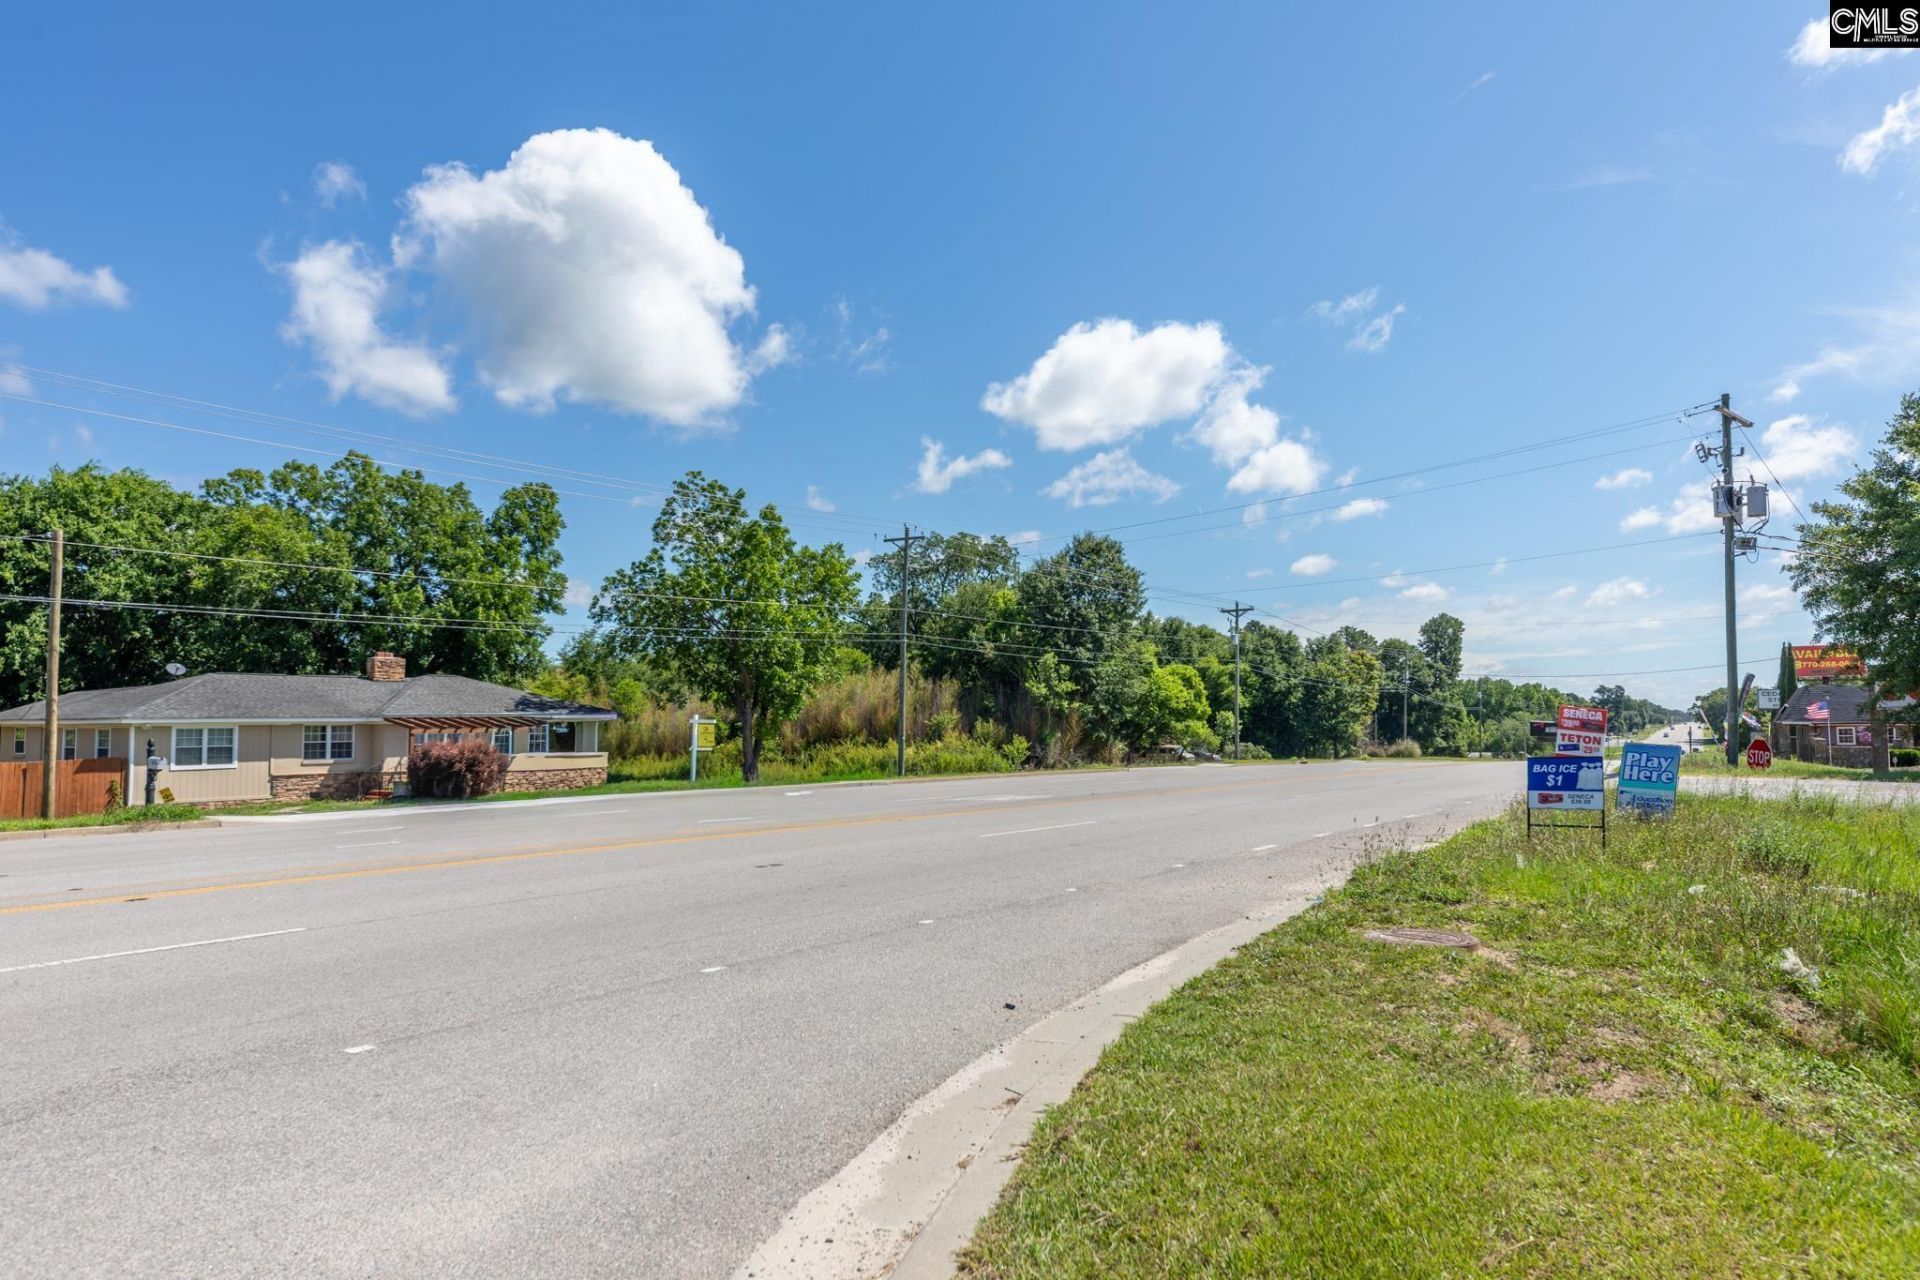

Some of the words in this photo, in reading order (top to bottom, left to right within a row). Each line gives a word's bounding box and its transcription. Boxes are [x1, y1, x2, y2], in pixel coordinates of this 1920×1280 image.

[1563, 708, 1603, 720] SENECA
[1560, 733, 1601, 745] TETON
[1625, 752, 1671, 771] Play
[1749, 750, 1770, 764] STOP
[1533, 764, 1557, 773] BAG
[1559, 764, 1578, 773] ICE
[1623, 766, 1674, 783] Here
[1546, 774, 1563, 787] $1
